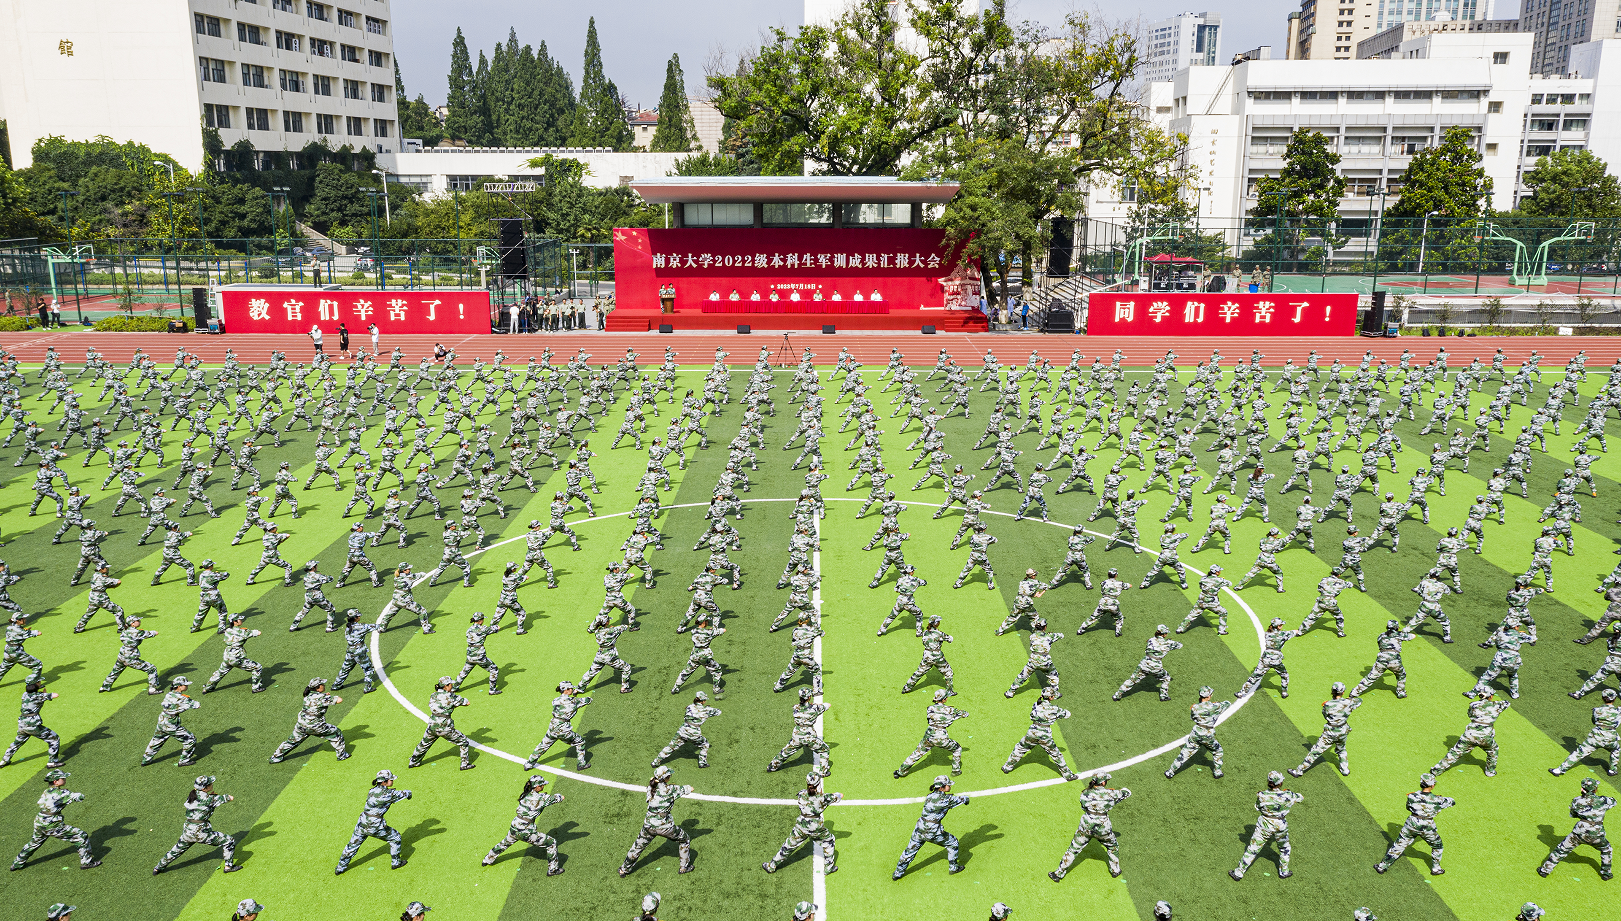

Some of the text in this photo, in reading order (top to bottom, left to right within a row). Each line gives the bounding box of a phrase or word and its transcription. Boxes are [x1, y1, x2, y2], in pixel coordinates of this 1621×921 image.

[651, 252, 941, 271] 南京大学2022级本科生军训成果汇报大会
